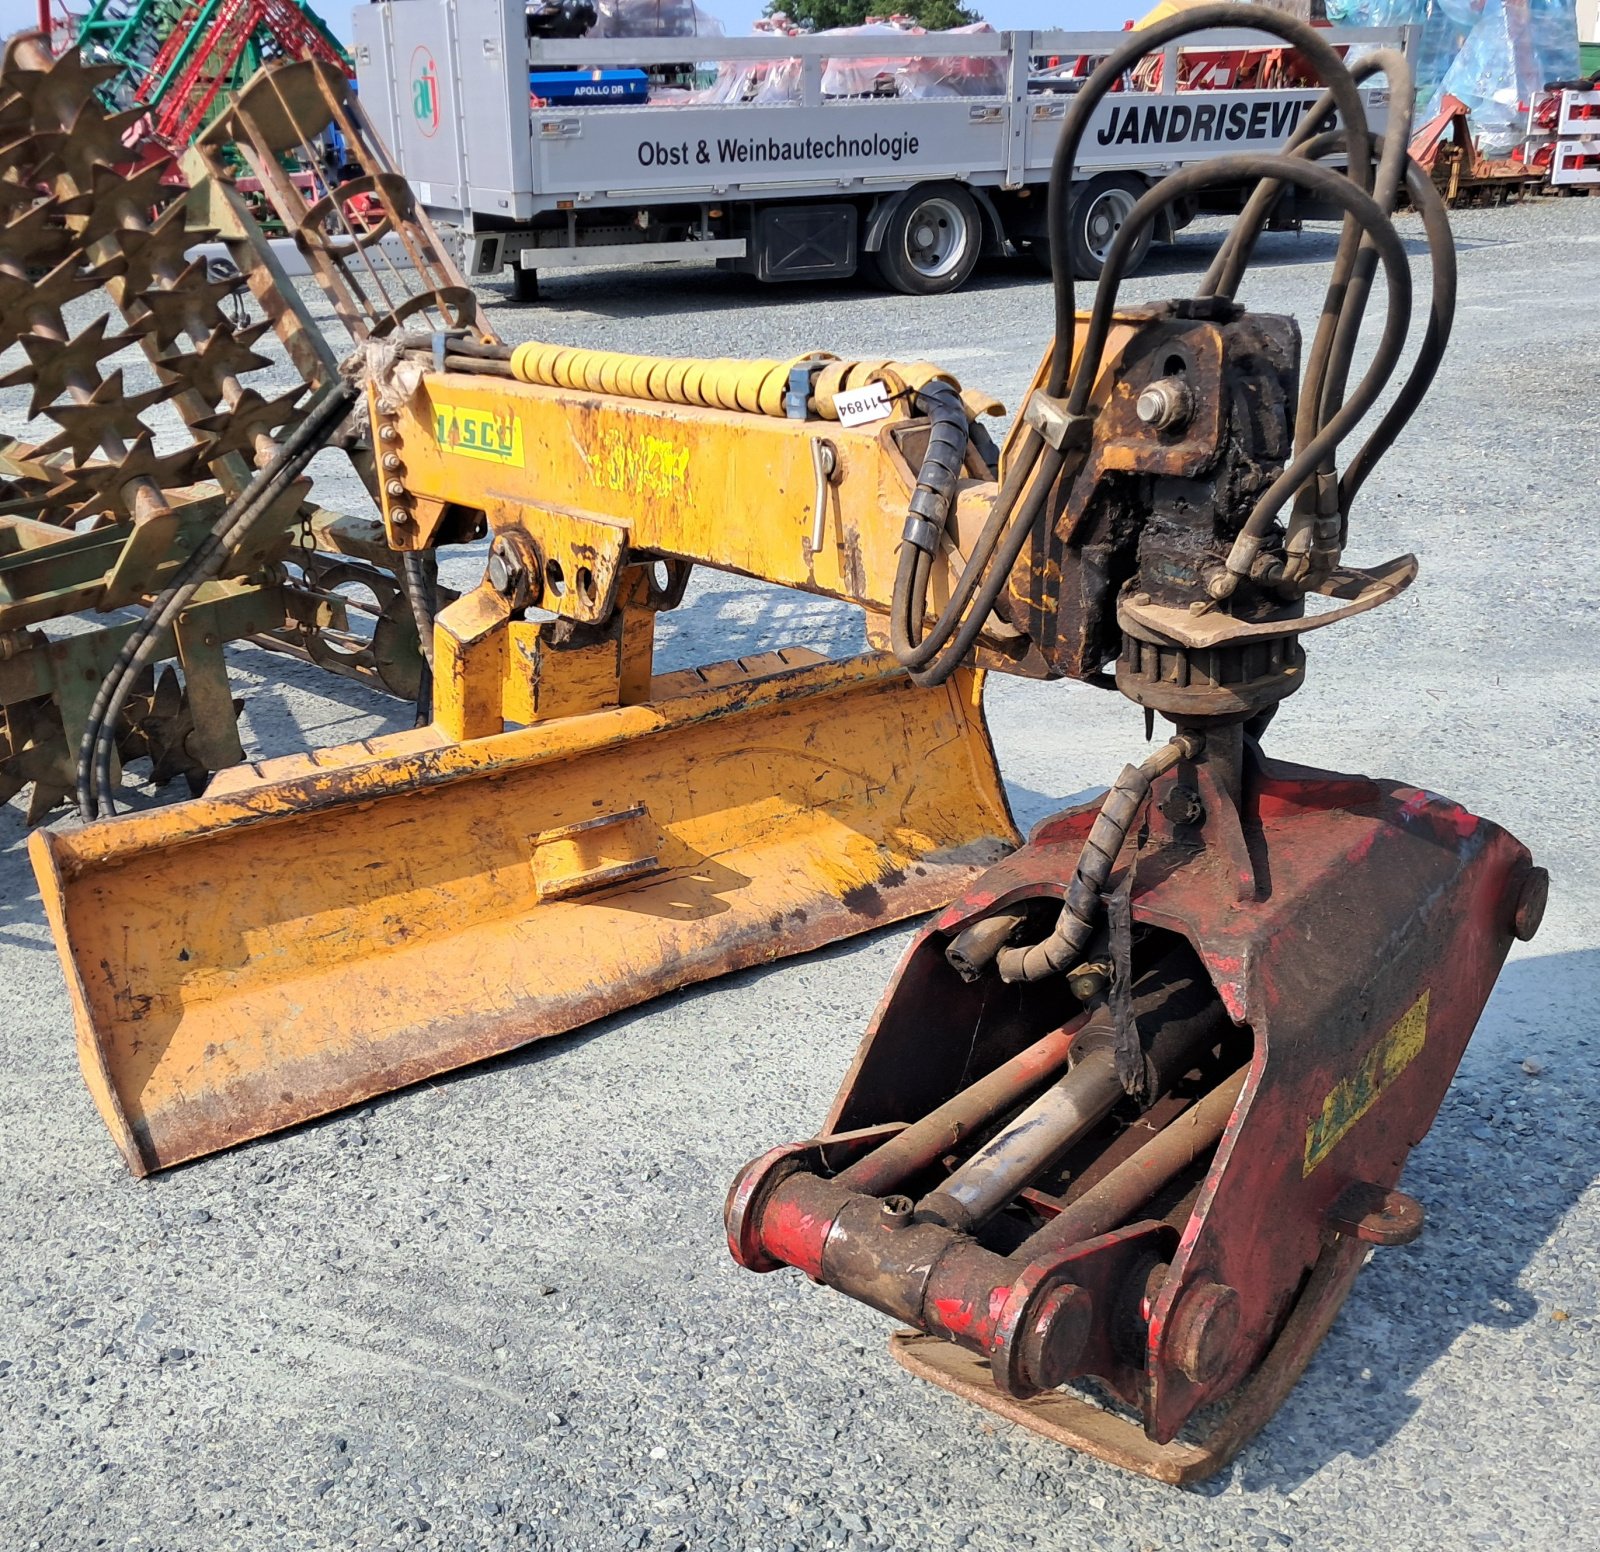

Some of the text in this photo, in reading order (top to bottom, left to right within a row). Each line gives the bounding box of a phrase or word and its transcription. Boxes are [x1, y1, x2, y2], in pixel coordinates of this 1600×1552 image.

[574, 85, 624, 96] APOLLO DR
[1097, 100, 1337, 146] JANDRISEVI
[638, 131, 919, 166] Obst & Weinbautechnologie
[839, 397, 878, 417] 11894
